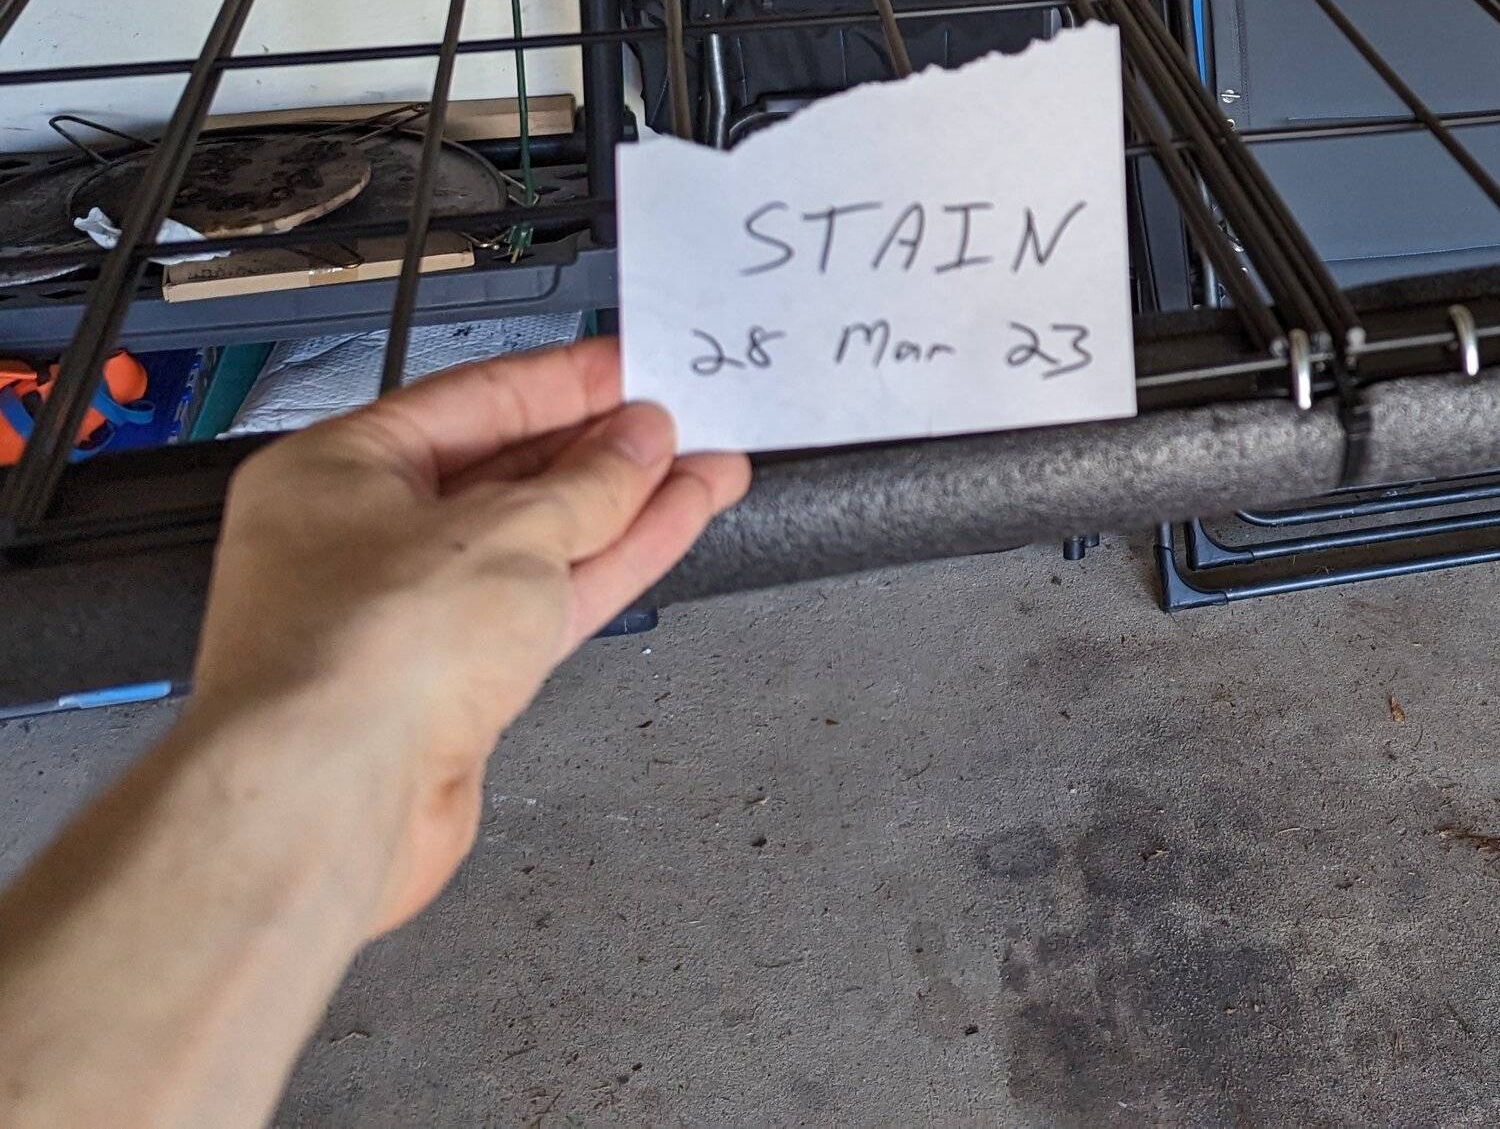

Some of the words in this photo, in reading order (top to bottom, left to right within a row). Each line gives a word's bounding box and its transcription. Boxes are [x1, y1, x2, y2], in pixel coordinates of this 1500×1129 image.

[742, 200, 1087, 276] STAIN
[689, 324, 787, 377] 28
[833, 318, 955, 366] Mar
[1004, 320, 1095, 379] 23
